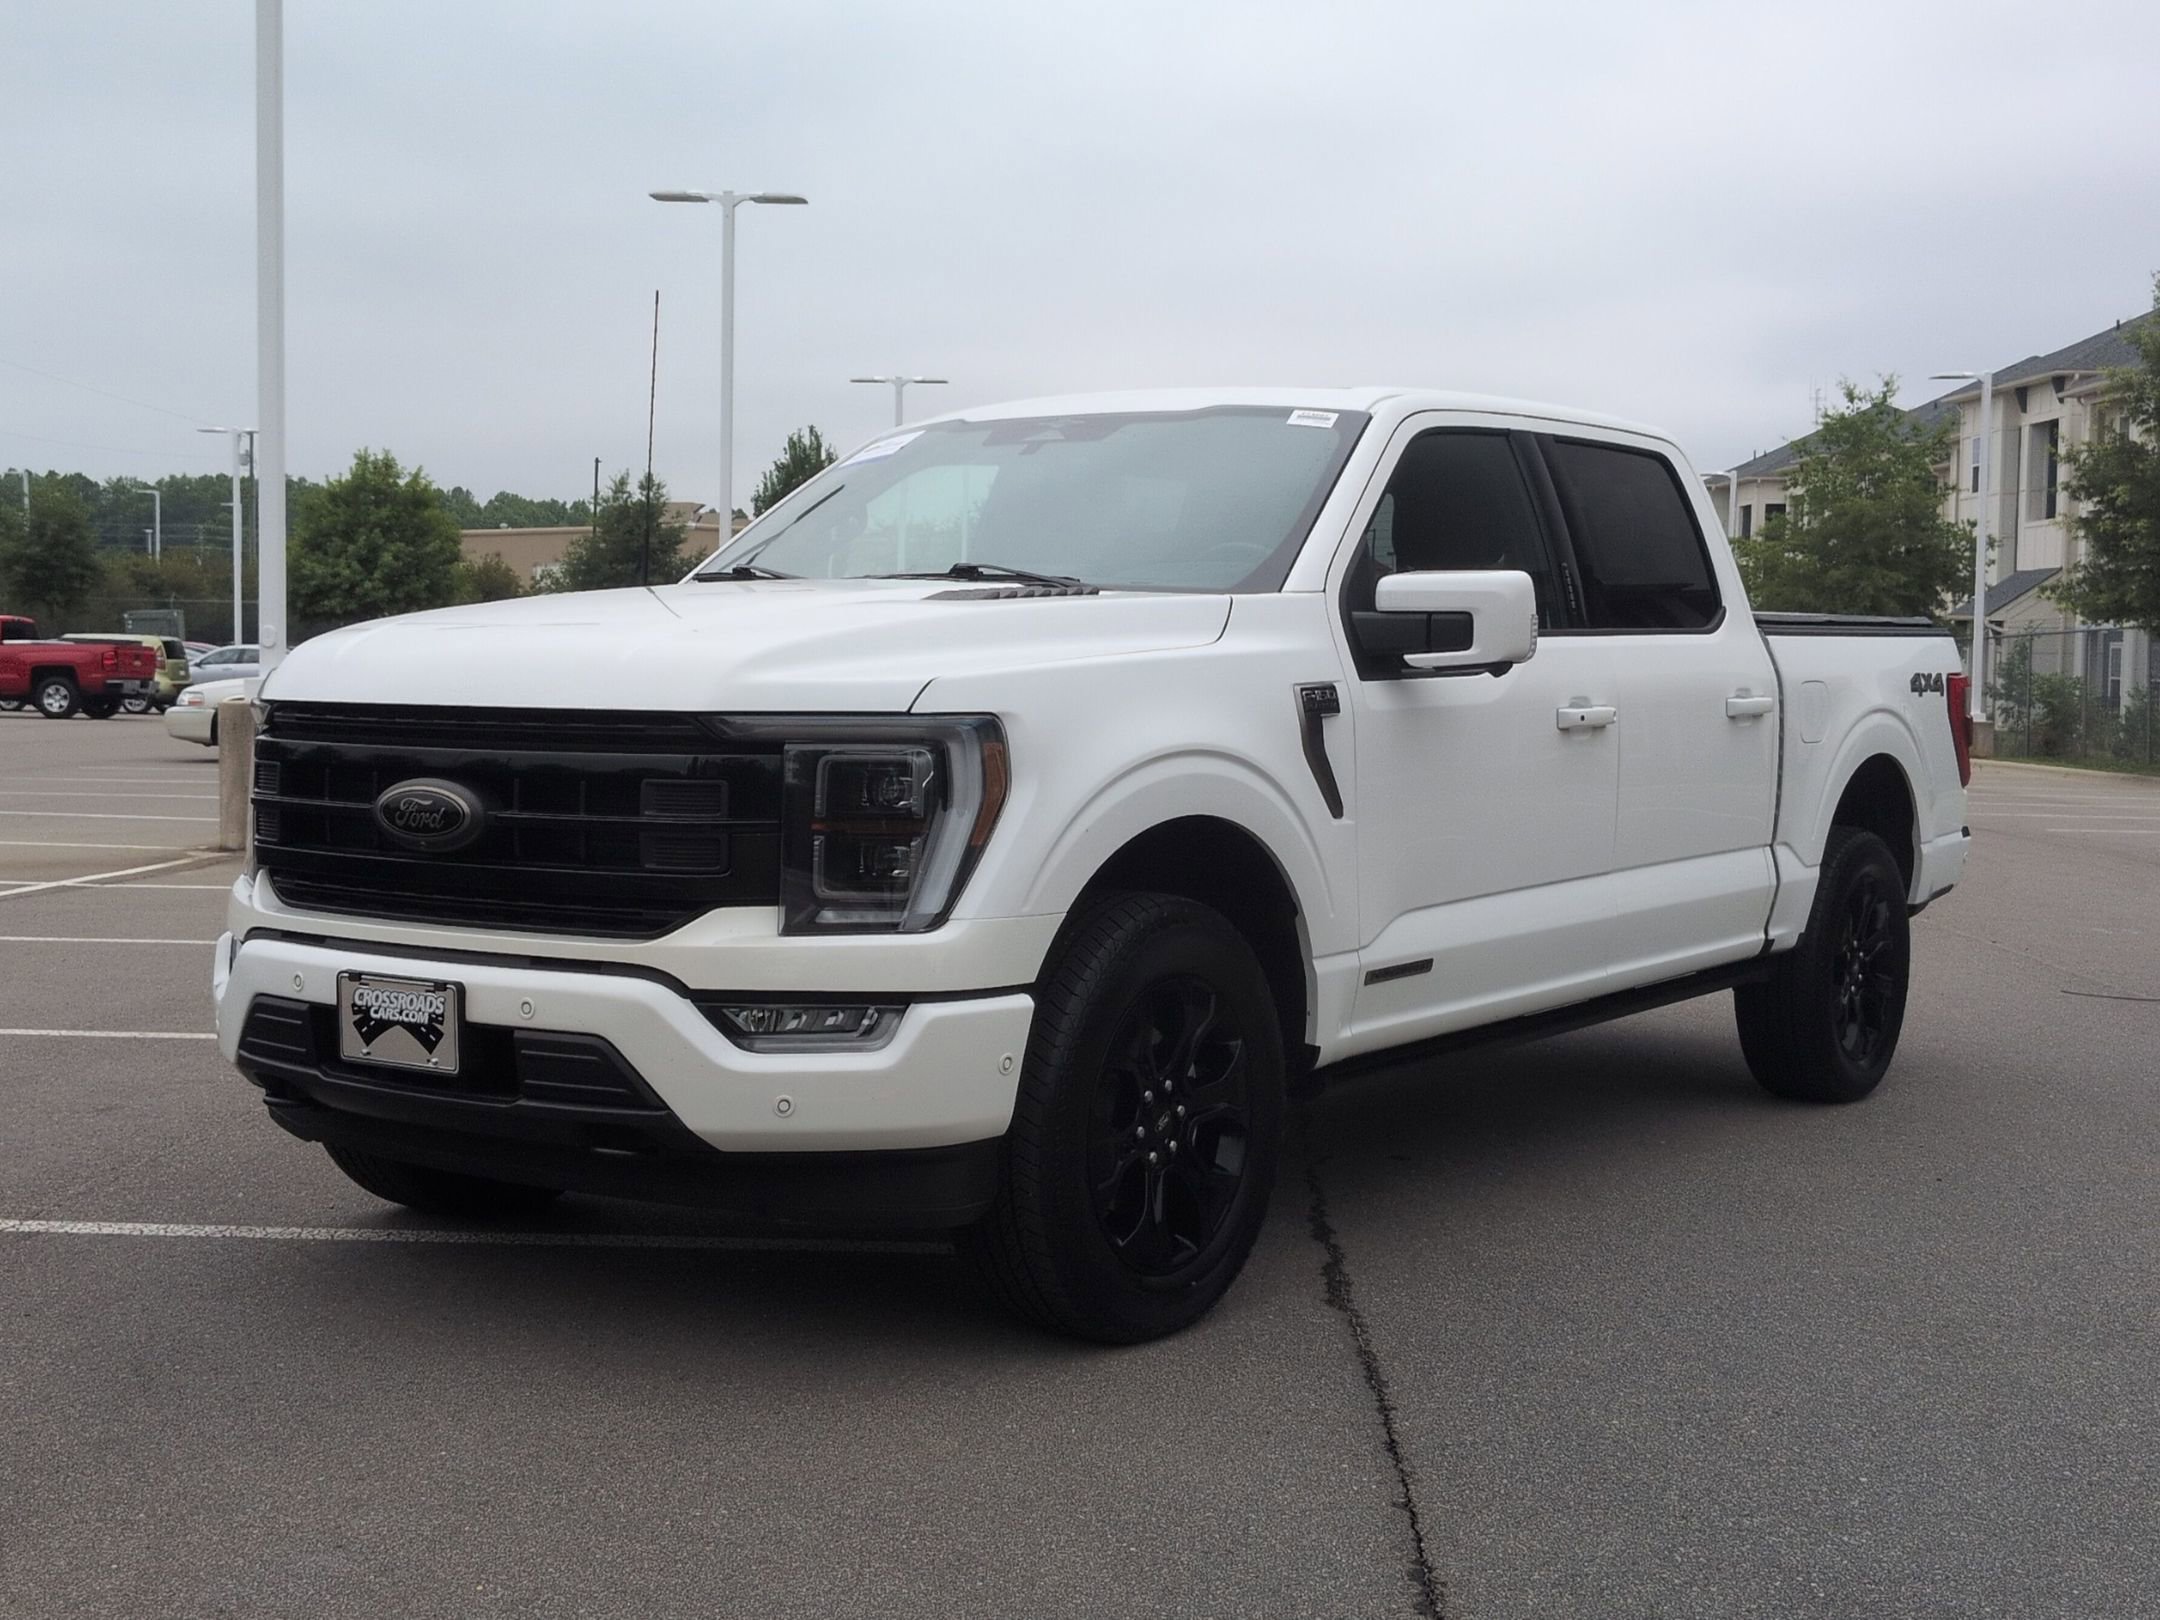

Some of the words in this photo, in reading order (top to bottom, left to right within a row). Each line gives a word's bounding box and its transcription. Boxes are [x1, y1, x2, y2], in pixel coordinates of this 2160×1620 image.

[395, 797, 445, 828] Ford
[353, 988, 445, 1014] CROSSROADS
[369, 1006, 430, 1024] CARS.COM
